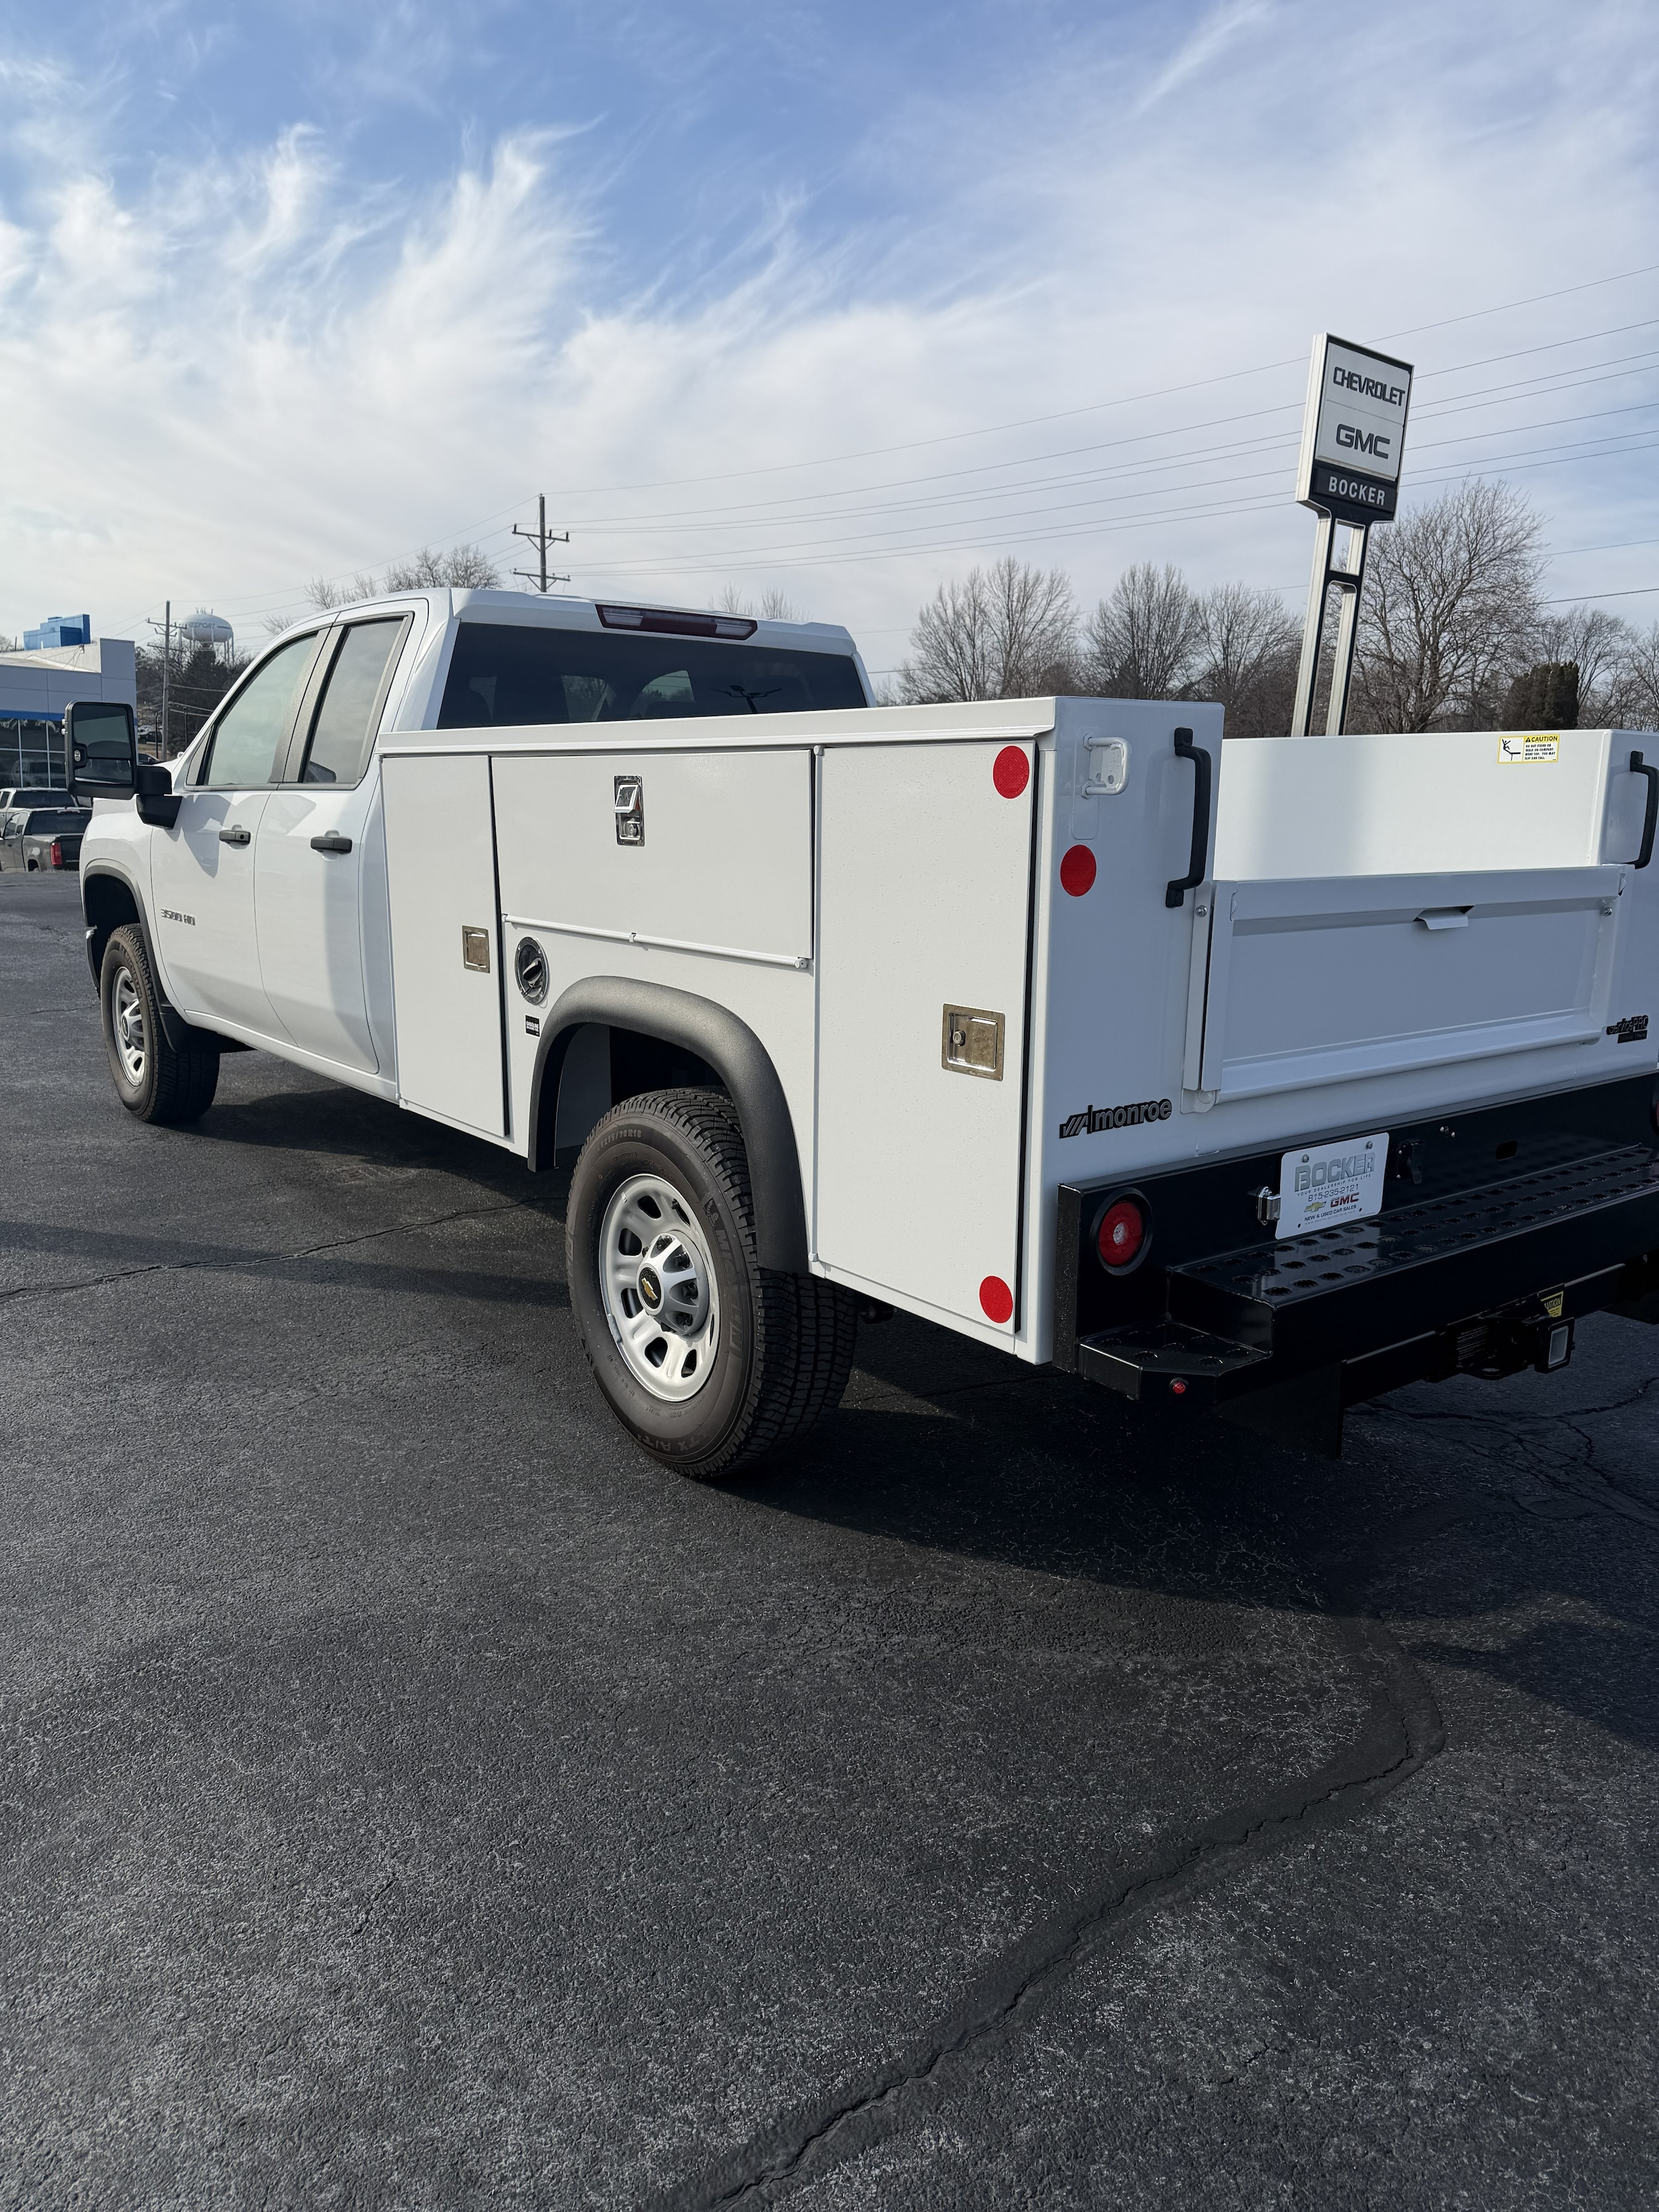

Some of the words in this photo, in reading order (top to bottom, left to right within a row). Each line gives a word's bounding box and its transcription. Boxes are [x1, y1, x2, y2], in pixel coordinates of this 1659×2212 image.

[1333, 366, 1406, 406] CHEVROLET
[1336, 423, 1390, 459] GMC
[1329, 476, 1386, 506] BOCKER
[1093, 1098, 1173, 1132] monroe
[1295, 1152, 1376, 1193] BOCKER
[1314, 1180, 1346, 1192] DEALERSHIP
[1308, 1183, 1358, 1202] 815-235-2121
[1330, 1192, 1360, 1208] GMC
[1544, 1297, 1561, 1310] UTION
